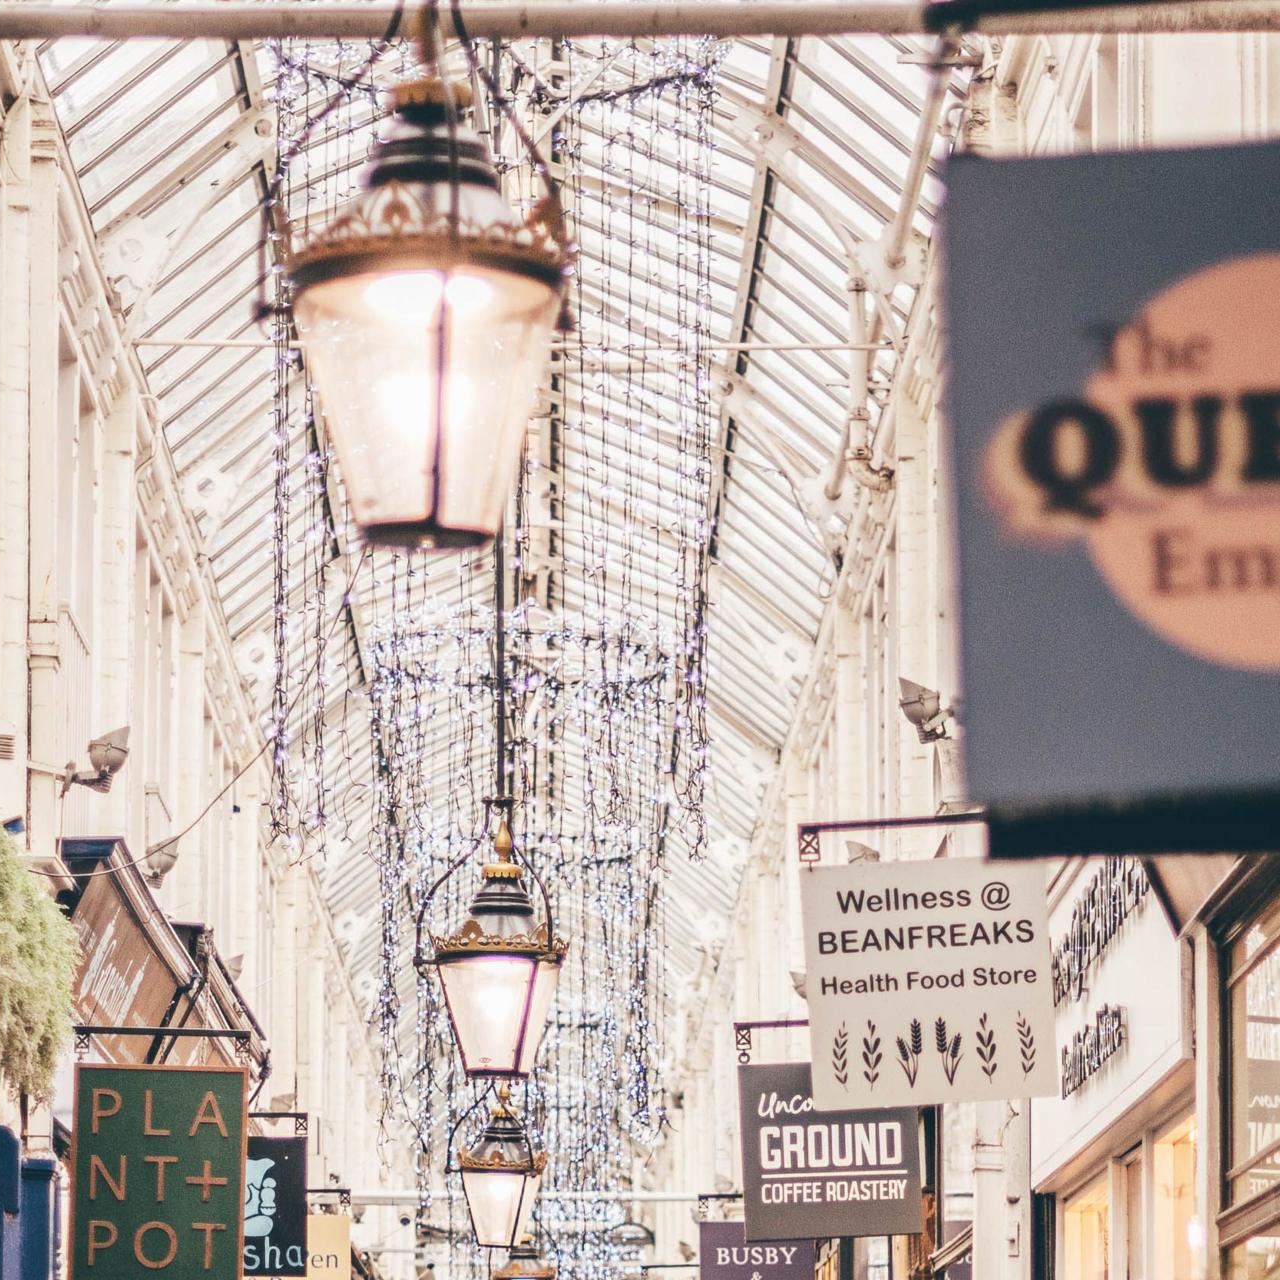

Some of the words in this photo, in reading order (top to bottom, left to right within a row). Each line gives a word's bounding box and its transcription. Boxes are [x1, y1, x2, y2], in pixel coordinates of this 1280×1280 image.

[1084, 312, 1213, 377] The
[836, 886, 972, 914] Wellness
[980, 881, 1011, 911] @
[817, 919, 1035, 955] BEANFREAKS
[820, 972, 899, 996] Health
[906, 968, 965, 990] Food
[972, 966, 1037, 987] Store
[759, 1121, 903, 1170] GROUND
[761, 1181, 822, 1204] COFFEE
[826, 1179, 908, 1202] ROASTERY
[86, 1219, 227, 1270] POT
[716, 1247, 797, 1265] BUSBY
